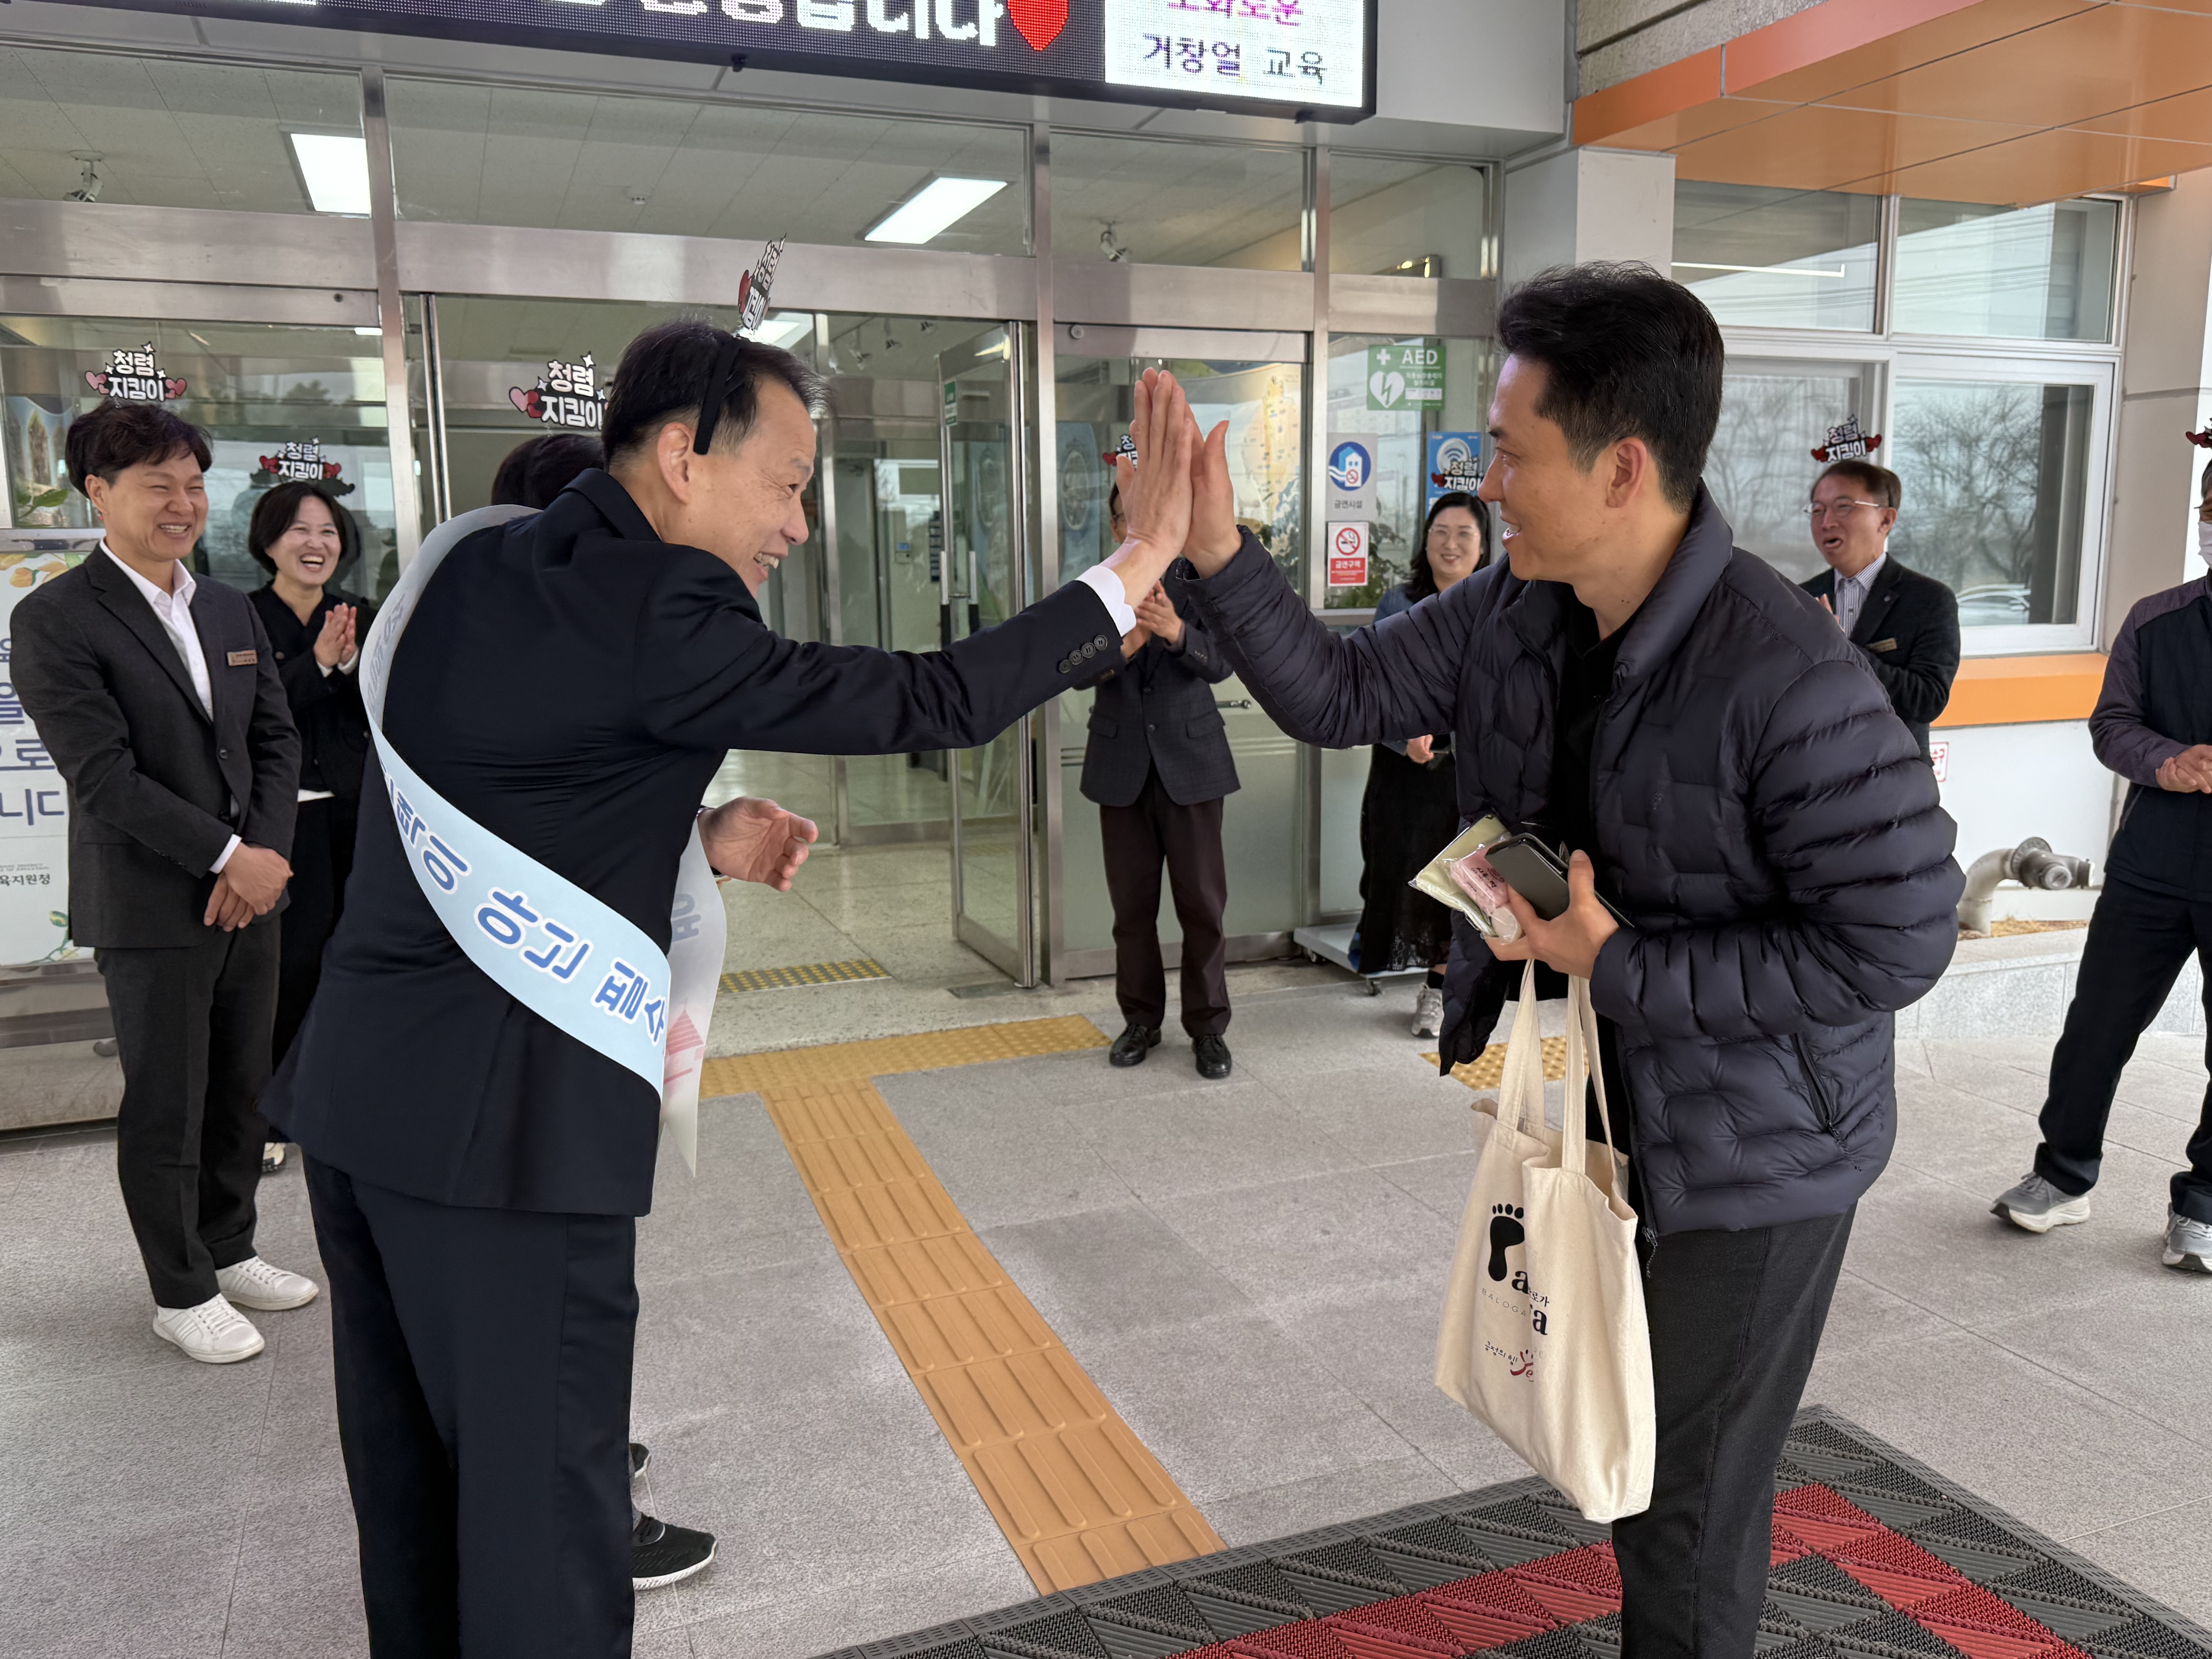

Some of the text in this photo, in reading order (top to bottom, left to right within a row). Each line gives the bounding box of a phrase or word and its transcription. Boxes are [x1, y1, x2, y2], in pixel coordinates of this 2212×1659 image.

[1263, 46, 1327, 86] 교육
[113, 350, 154, 376] 청렴
[1401, 350, 1437, 365] AED
[548, 360, 594, 397] 청렴
[108, 377, 164, 402] 지킴이
[541, 395, 603, 430] 지킴이
[1828, 424, 1858, 444] 청렴
[286, 442, 318, 460] 청렴
[1825, 440, 1866, 462] 지킴이
[278, 460, 323, 480] 지킴이
[1451, 461, 1477, 476] 청렴
[1444, 476, 1482, 491] 지킴이
[1335, 560, 1361, 569] 금연구역
[477, 891, 590, 980] 아닌
[595, 962, 665, 1042] 필수
